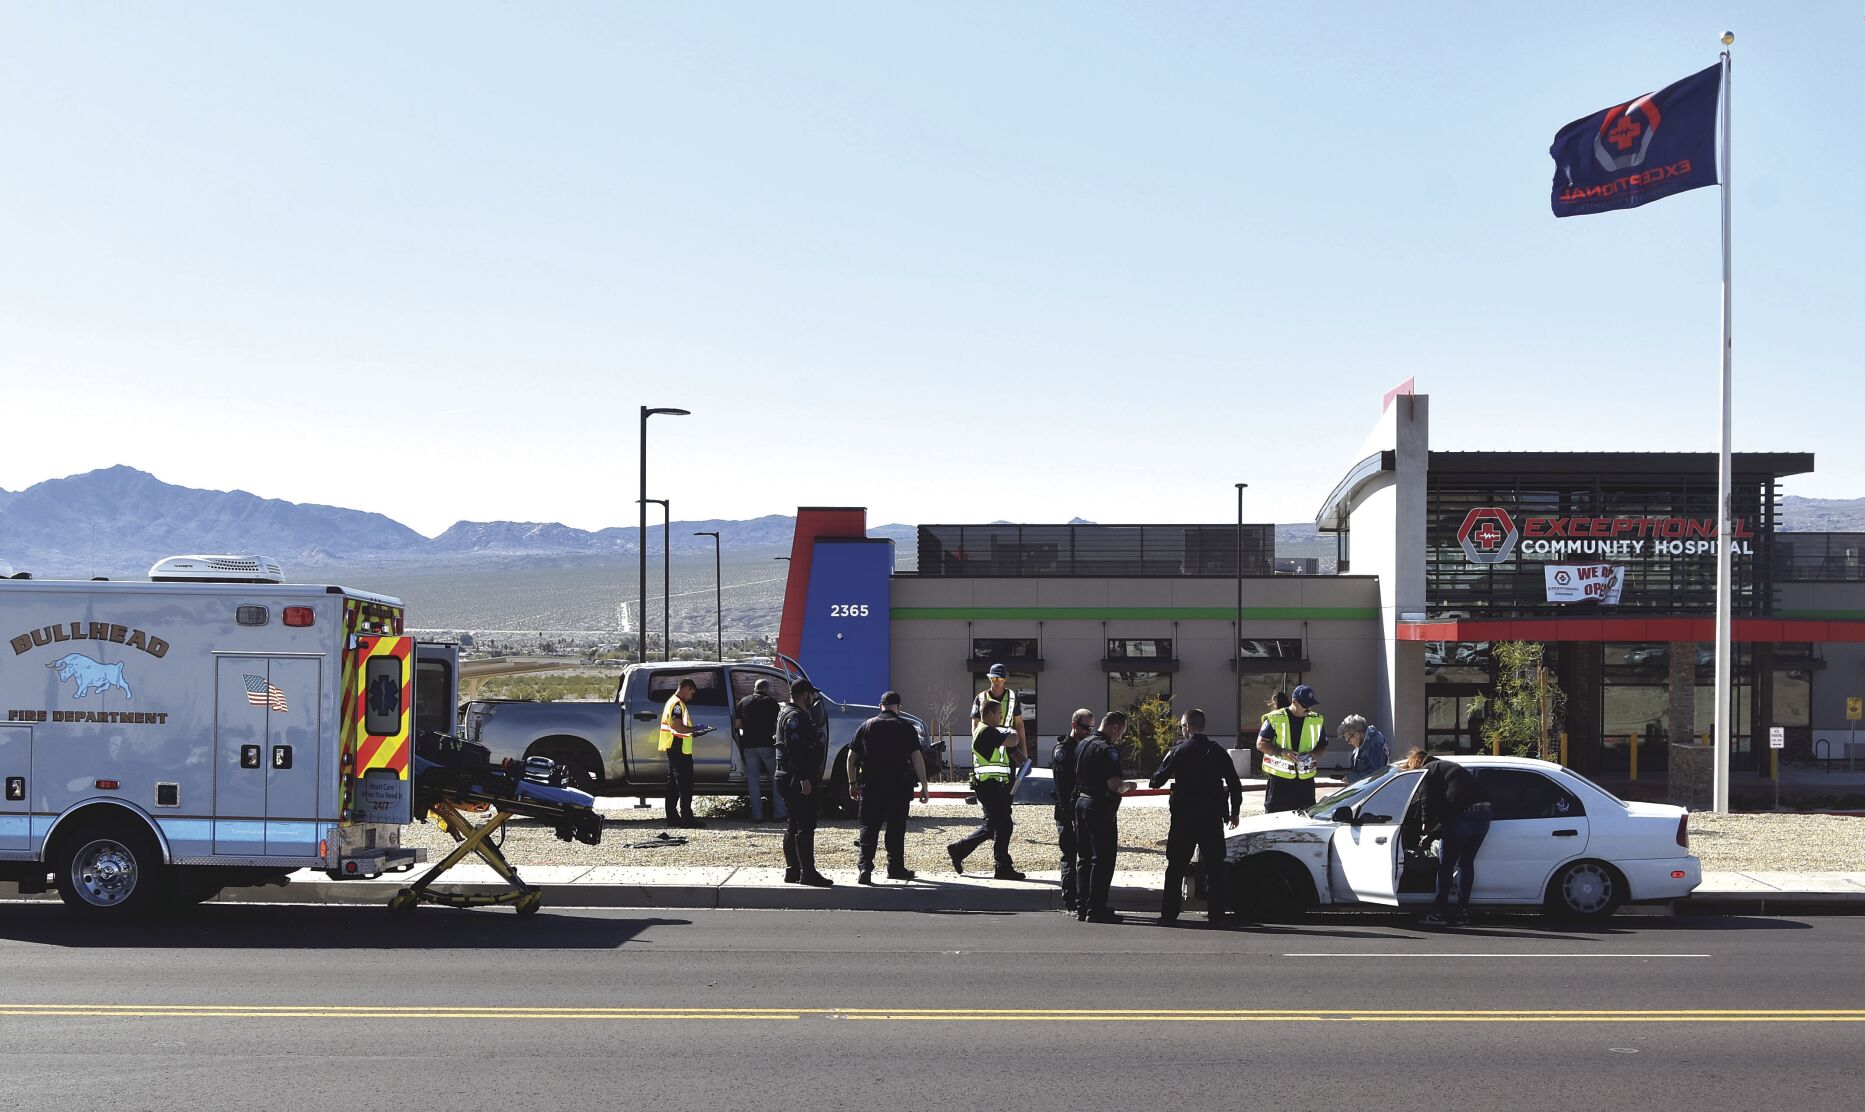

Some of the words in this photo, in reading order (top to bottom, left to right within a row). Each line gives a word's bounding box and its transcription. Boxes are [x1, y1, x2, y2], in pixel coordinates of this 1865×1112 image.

[1521, 539, 1643, 554] COMMUNITY
[1655, 540, 1753, 555] HOSPIAL
[1577, 566, 1598, 580] WE
[830, 604, 869, 617] 2365
[10, 621, 169, 659] BULLHEAD
[8, 709, 47, 722] FIRE
[52, 710, 168, 724] DEPARTMENT
